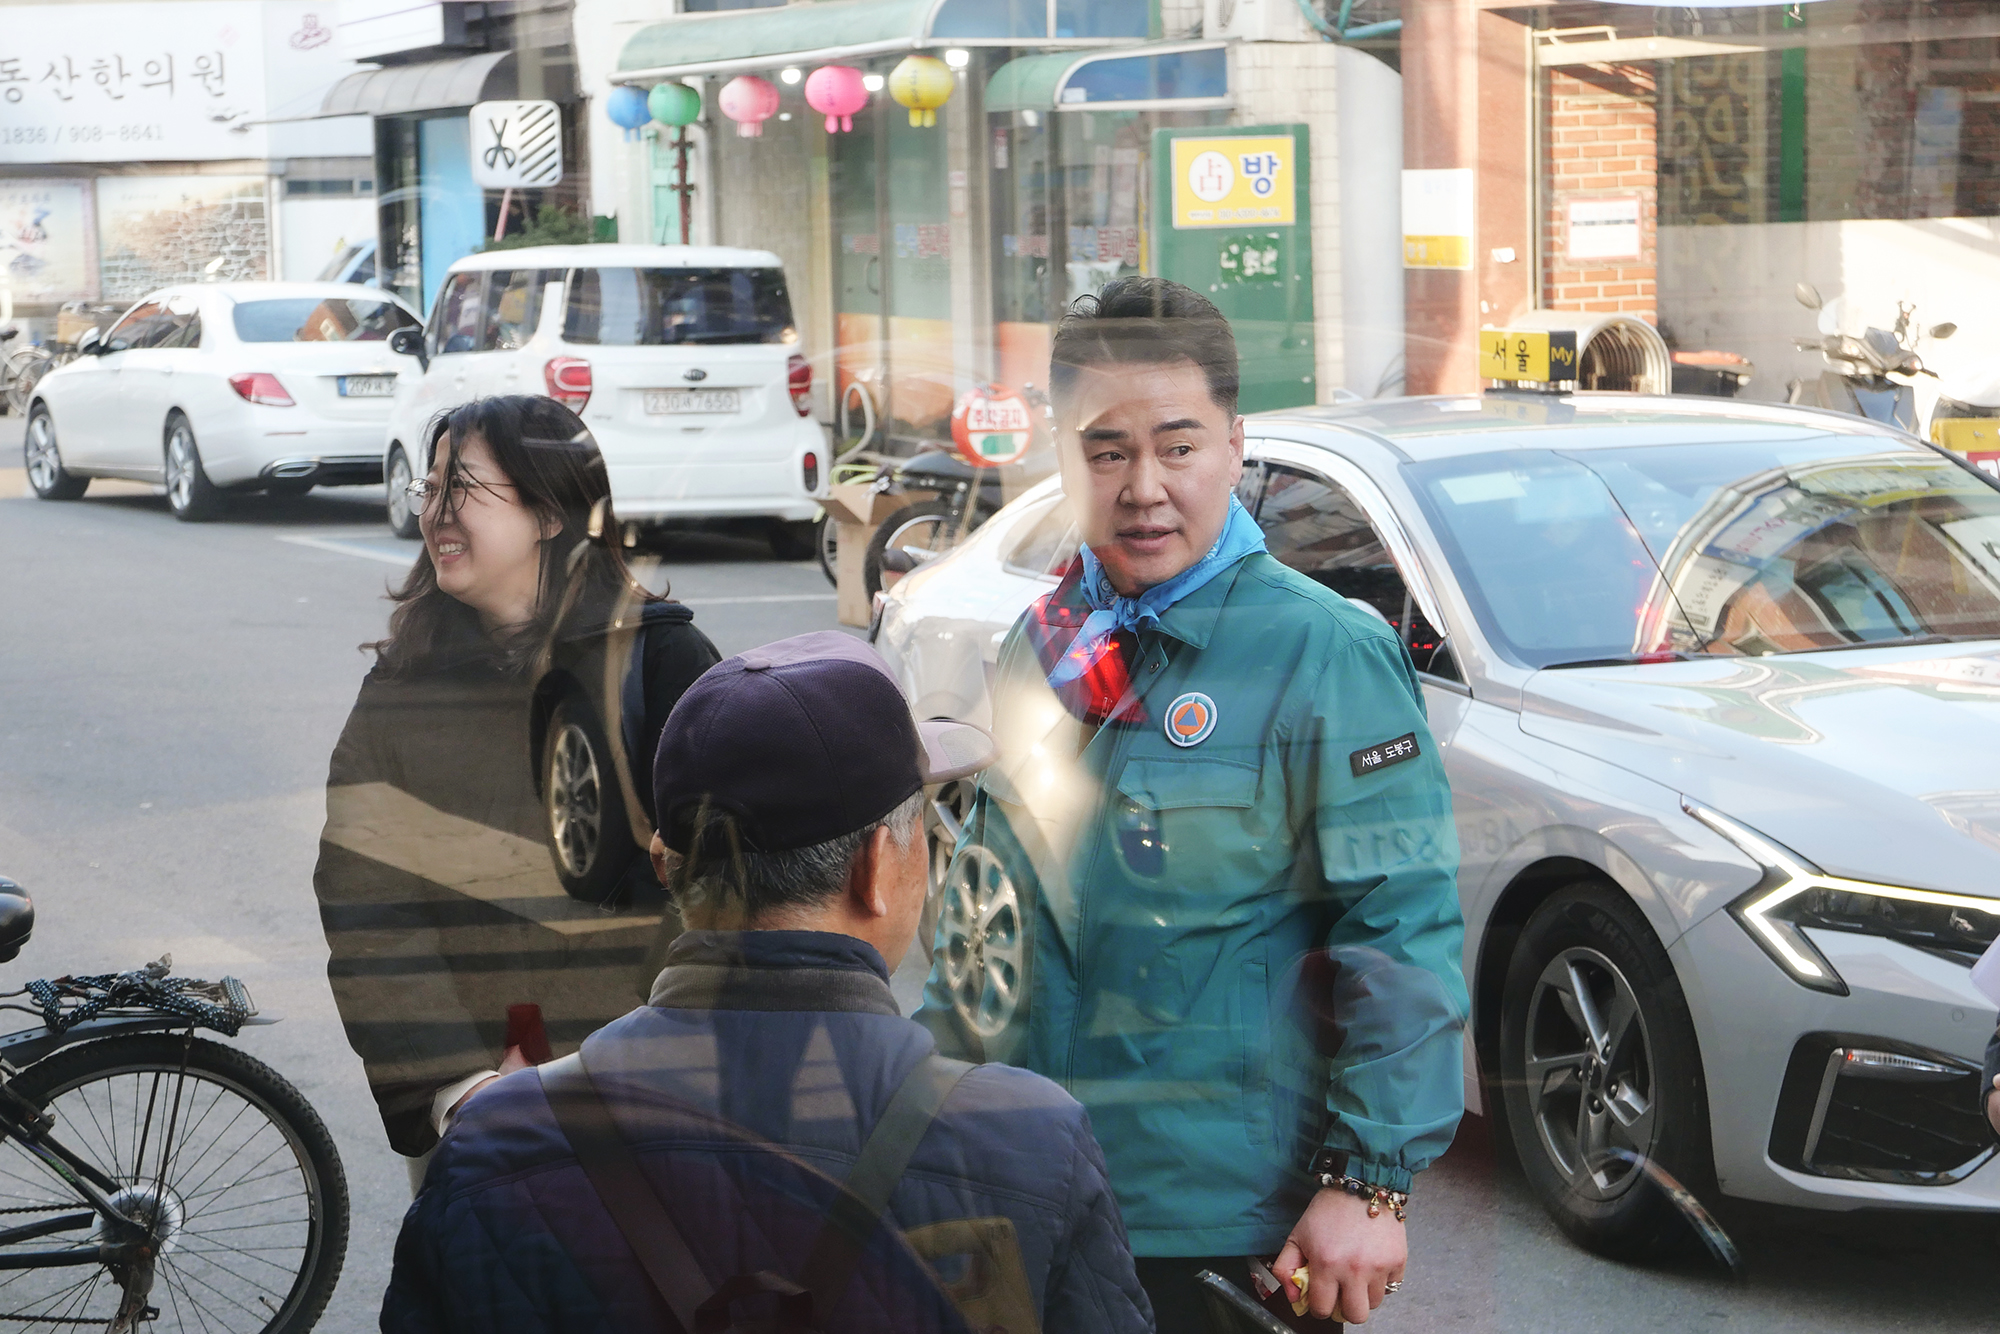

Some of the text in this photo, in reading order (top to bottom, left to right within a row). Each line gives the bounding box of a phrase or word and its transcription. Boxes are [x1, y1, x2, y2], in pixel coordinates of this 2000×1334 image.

[0, 51, 225, 104] 동산한의원
[68, 123, 165, 144] 908-8641
[1492, 338, 1530, 373] 서울
[1550, 346, 1574, 367] My
[1361, 739, 1413, 768] 서울 도봉구
